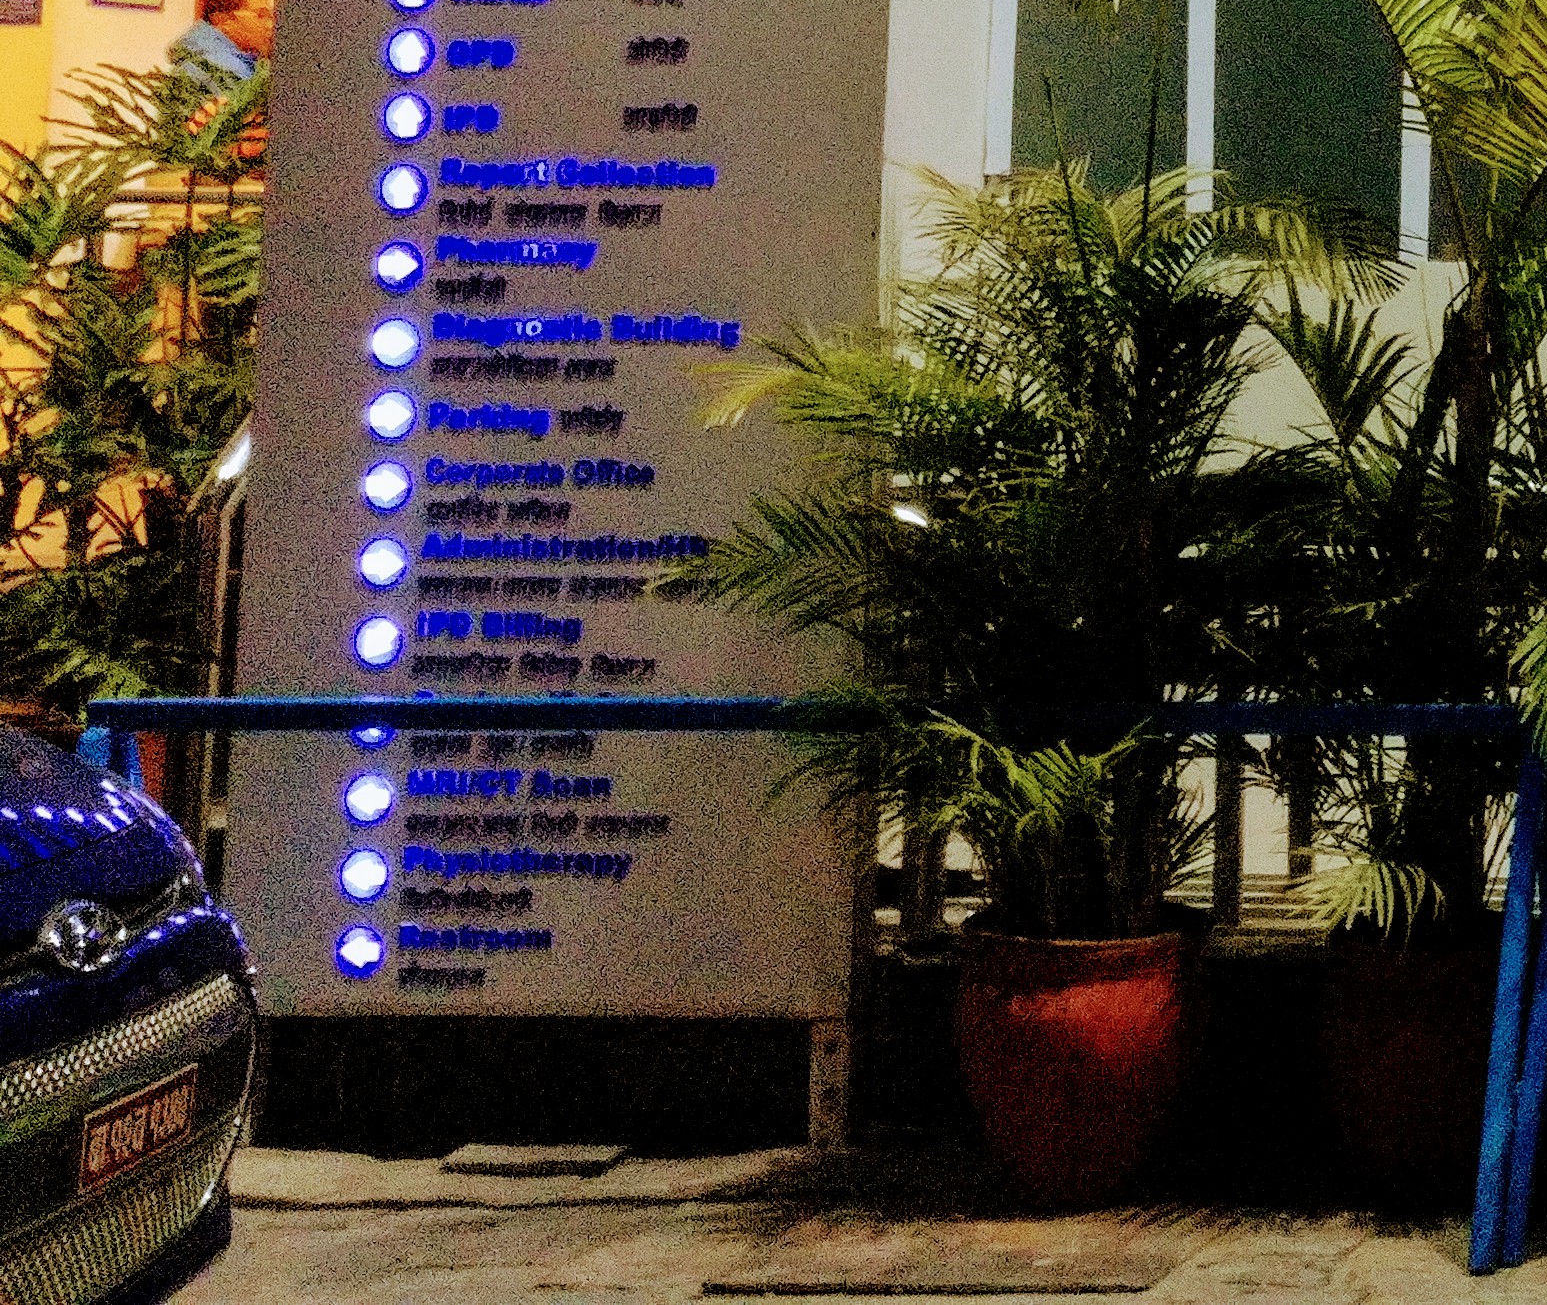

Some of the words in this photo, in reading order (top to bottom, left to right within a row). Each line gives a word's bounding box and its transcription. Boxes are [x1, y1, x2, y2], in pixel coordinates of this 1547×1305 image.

[440, 157, 549, 190] Report
[556, 157, 716, 188] Collection
[436, 235, 597, 270] Pharmacy
[432, 313, 601, 346] Diagnostic
[611, 314, 740, 350] Building
[429, 402, 550, 437] Parking
[425, 457, 565, 489] Corporate
[572, 458, 655, 487] Office
[482, 611, 583, 643] Billing
[531, 770, 614, 797] Scan
[403, 845, 633, 881] Physiotherapy
